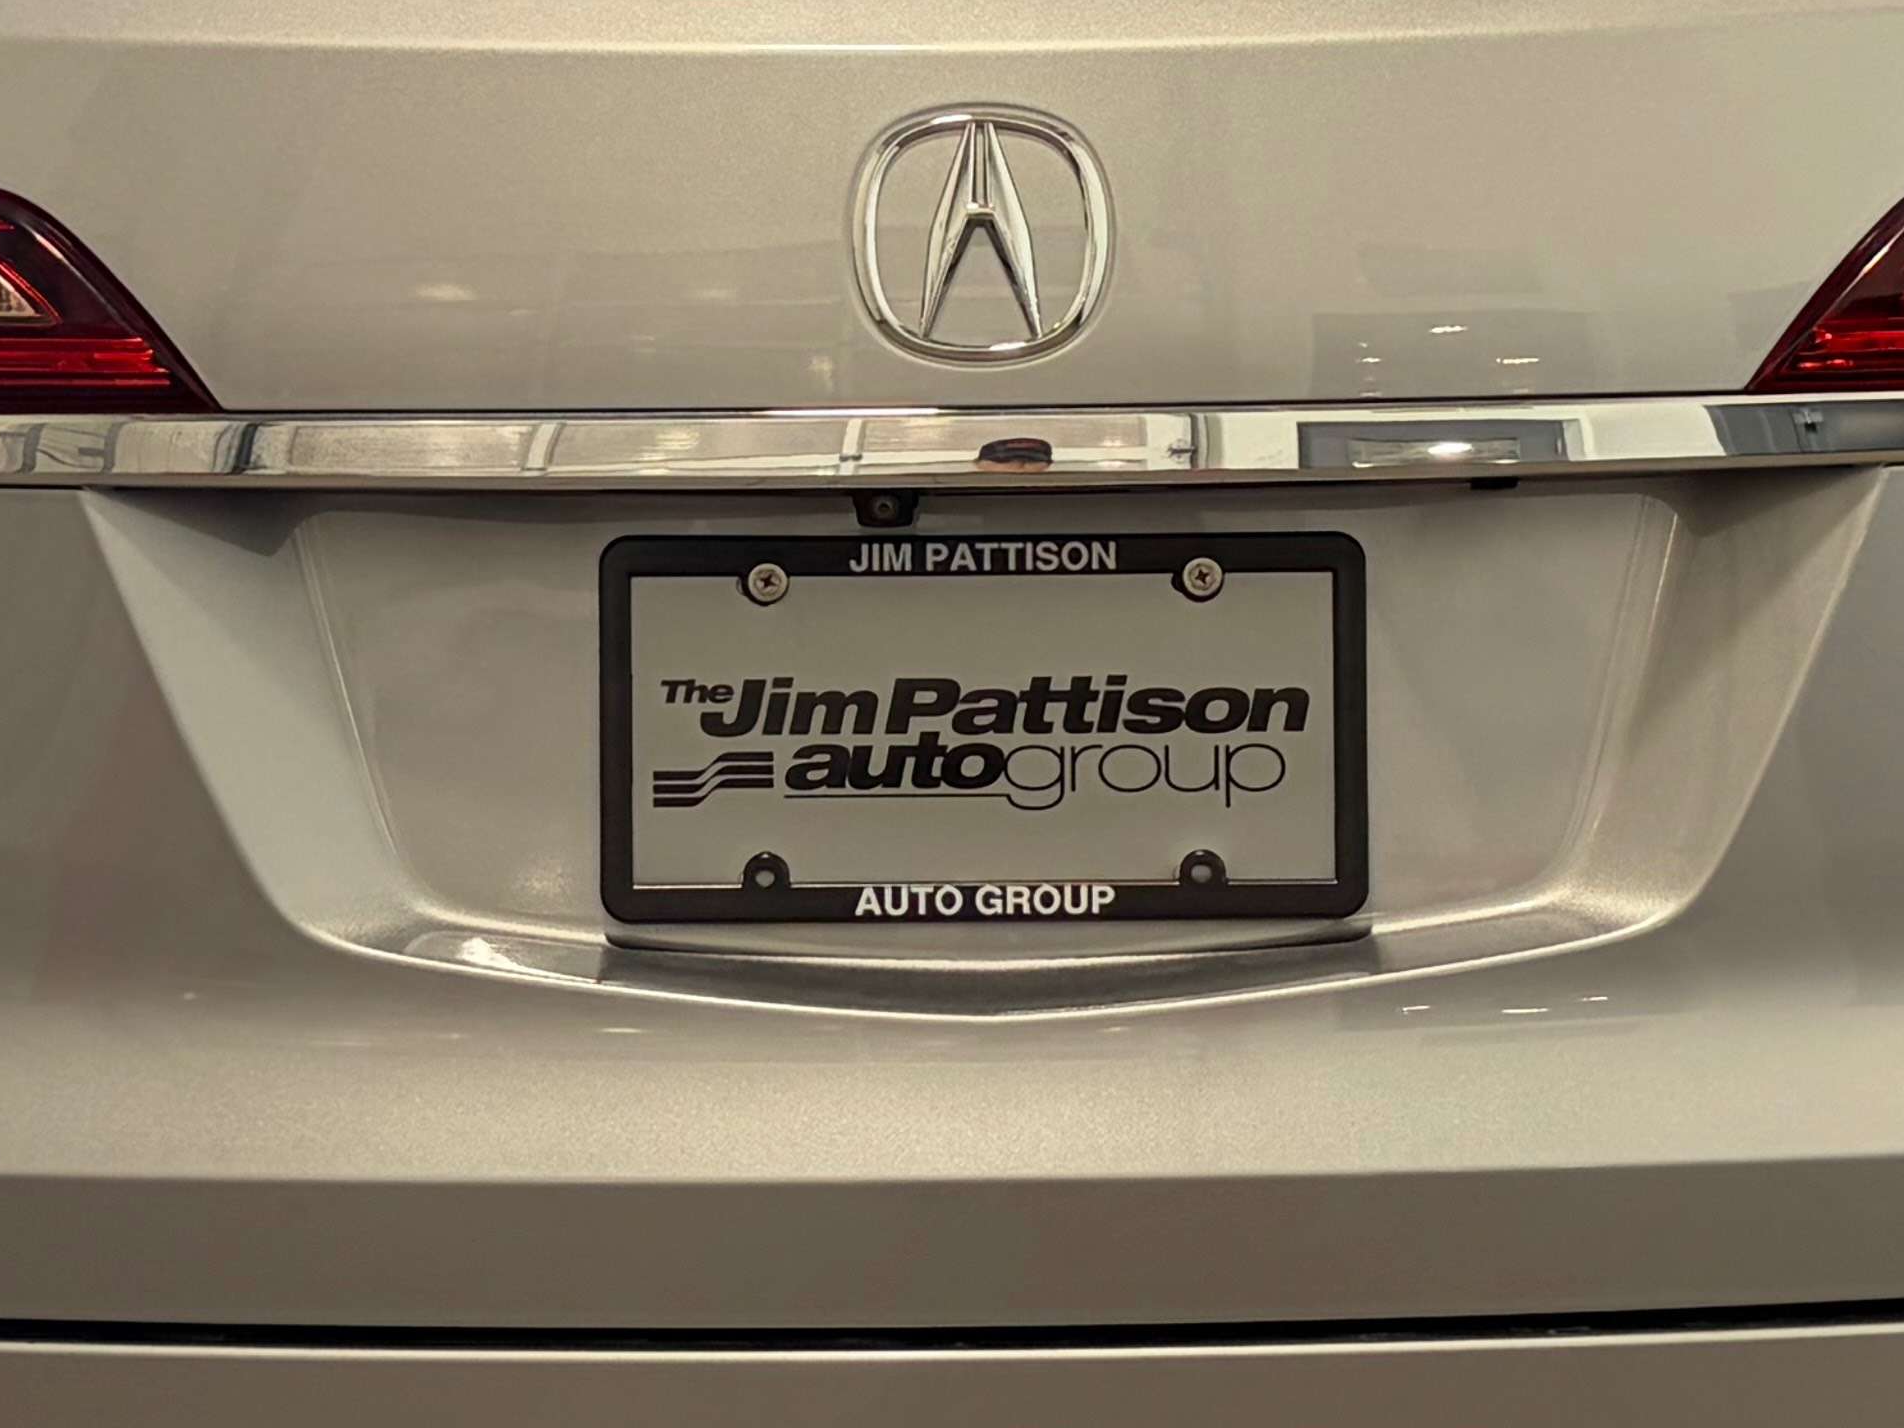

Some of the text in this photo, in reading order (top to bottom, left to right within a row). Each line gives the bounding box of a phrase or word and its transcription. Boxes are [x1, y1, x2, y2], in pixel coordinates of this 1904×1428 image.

[849, 541, 1117, 572] JIM PATTISON
[660, 675, 1310, 737] The Jim Pattison
[855, 884, 1115, 916] AUTO GROUP
